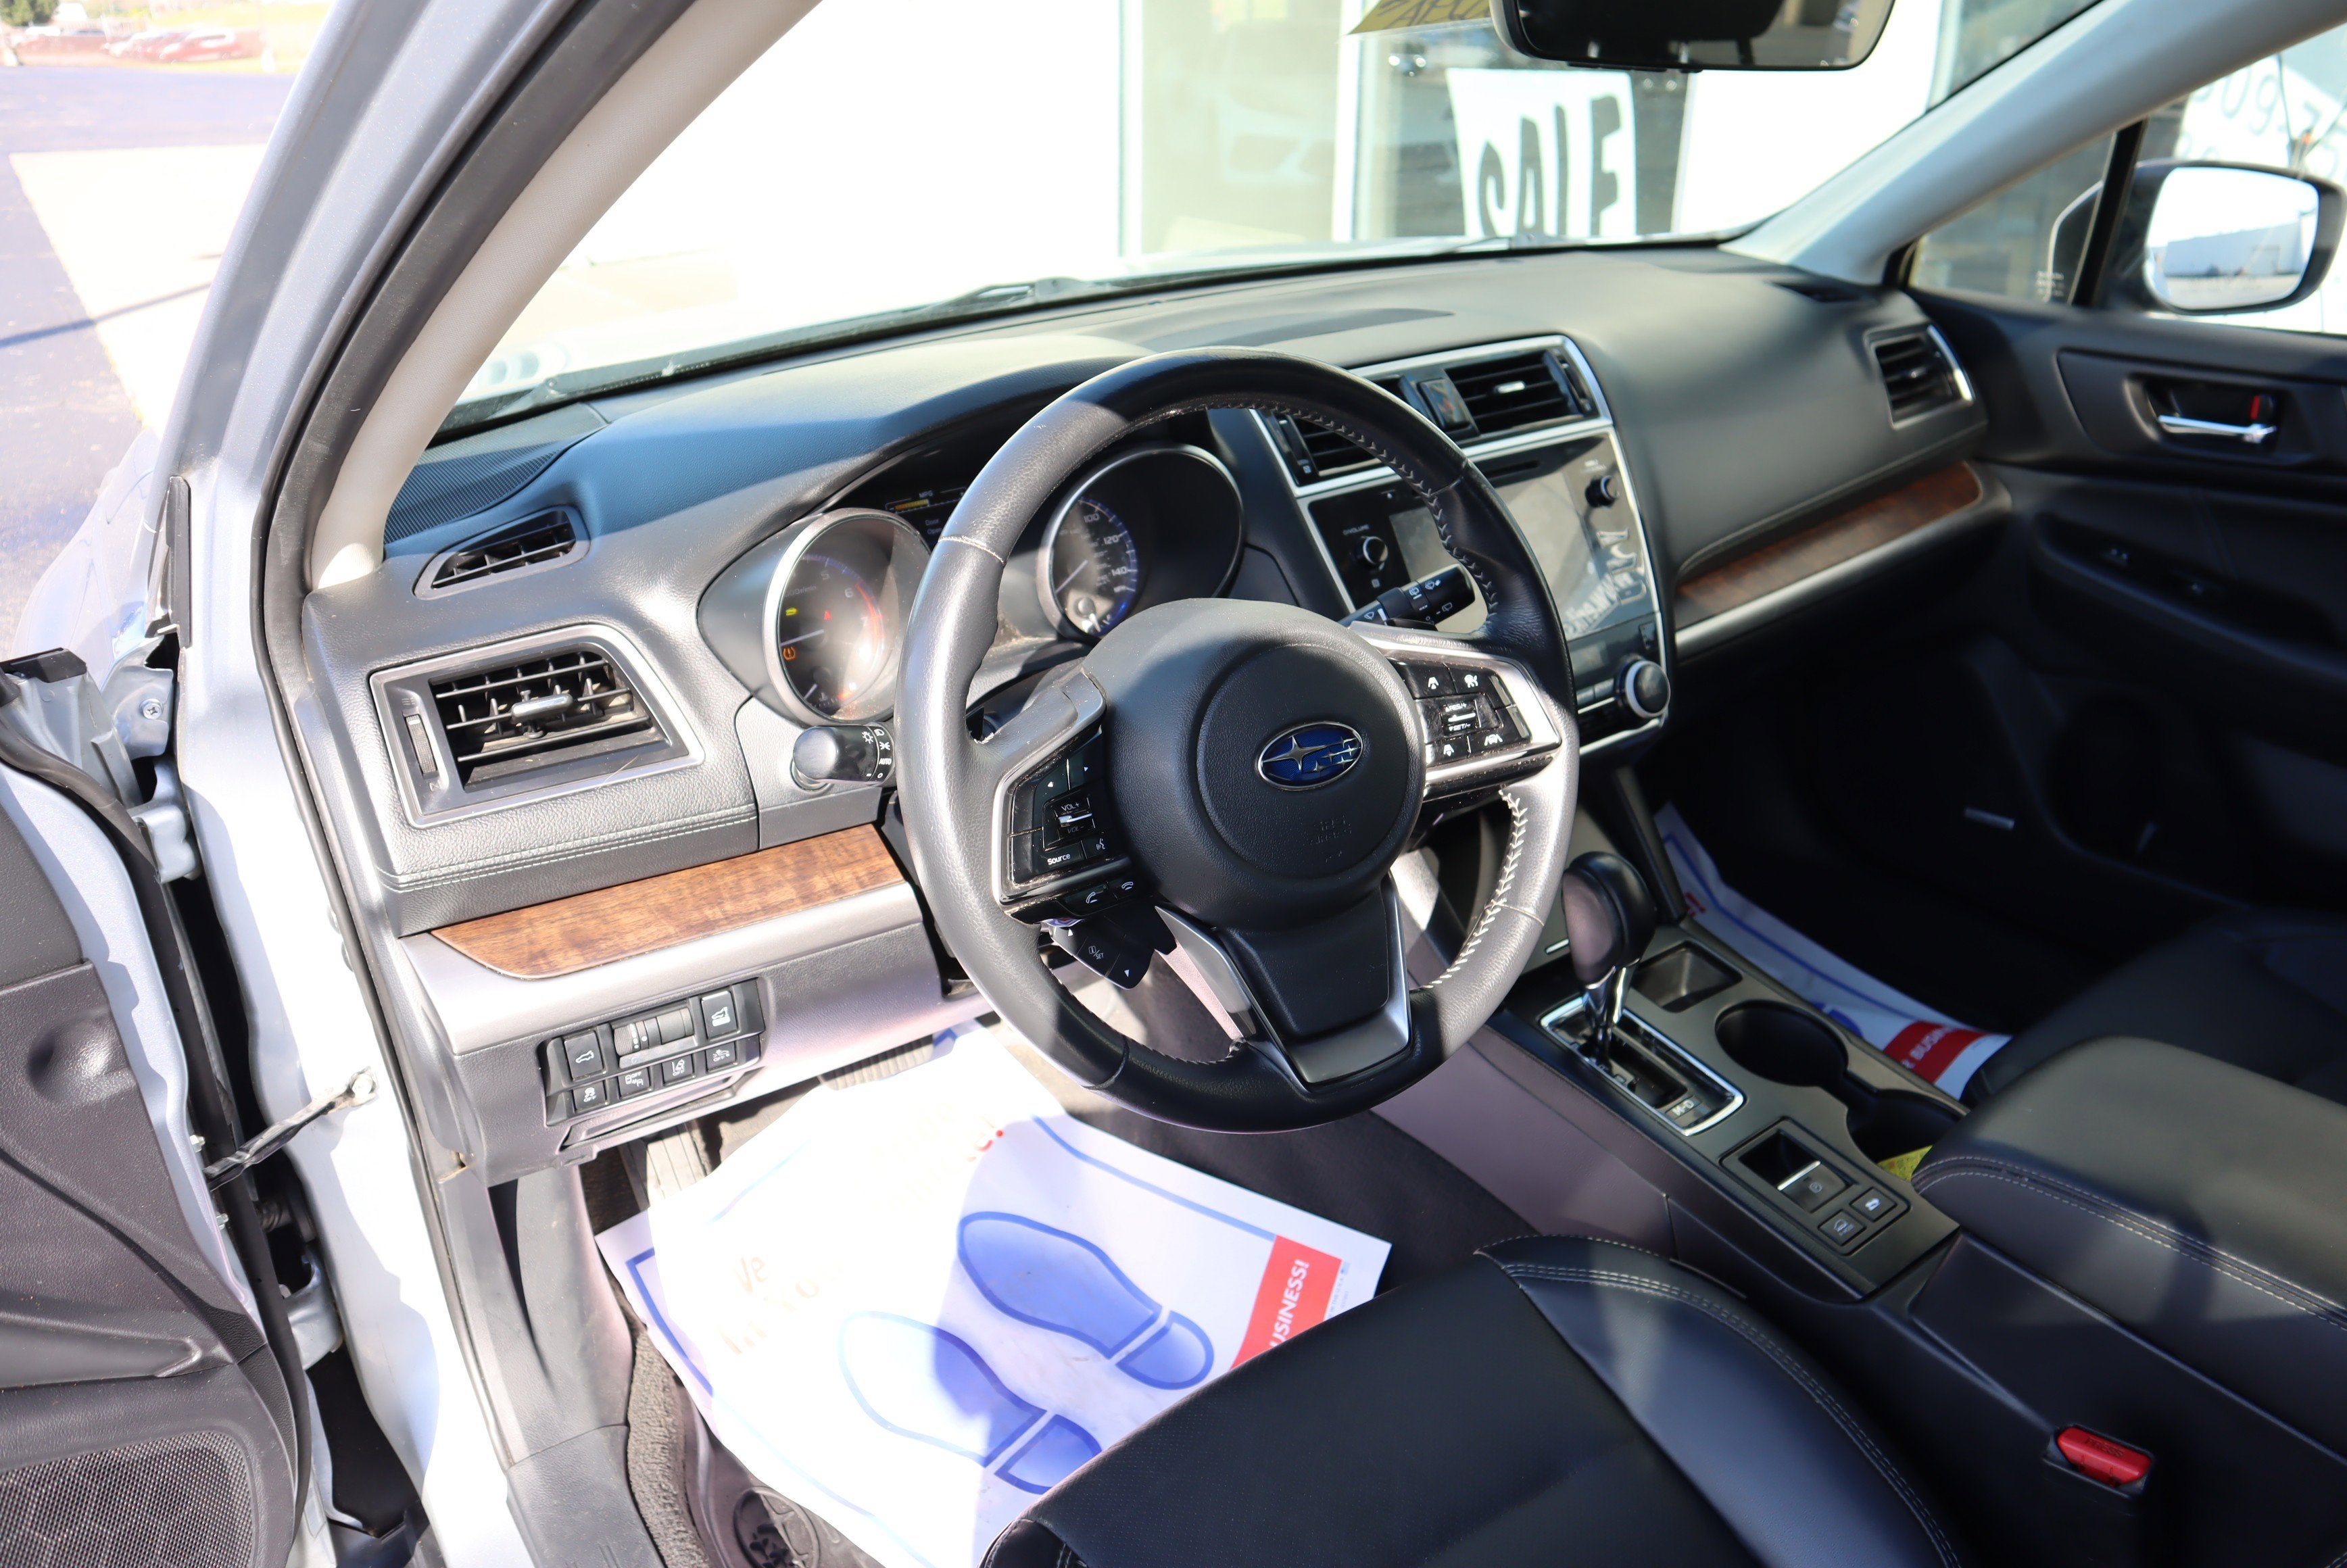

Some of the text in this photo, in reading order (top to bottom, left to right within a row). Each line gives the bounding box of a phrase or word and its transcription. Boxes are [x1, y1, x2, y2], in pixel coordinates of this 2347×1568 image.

[1084, 513, 1100, 523] 100
[1103, 535, 1119, 545] 120
[1111, 566, 1128, 576] 140
[844, 587, 854, 598] 6
[1047, 853, 1071, 865] Source
[1268, 1259, 1309, 1348] USINESS!
